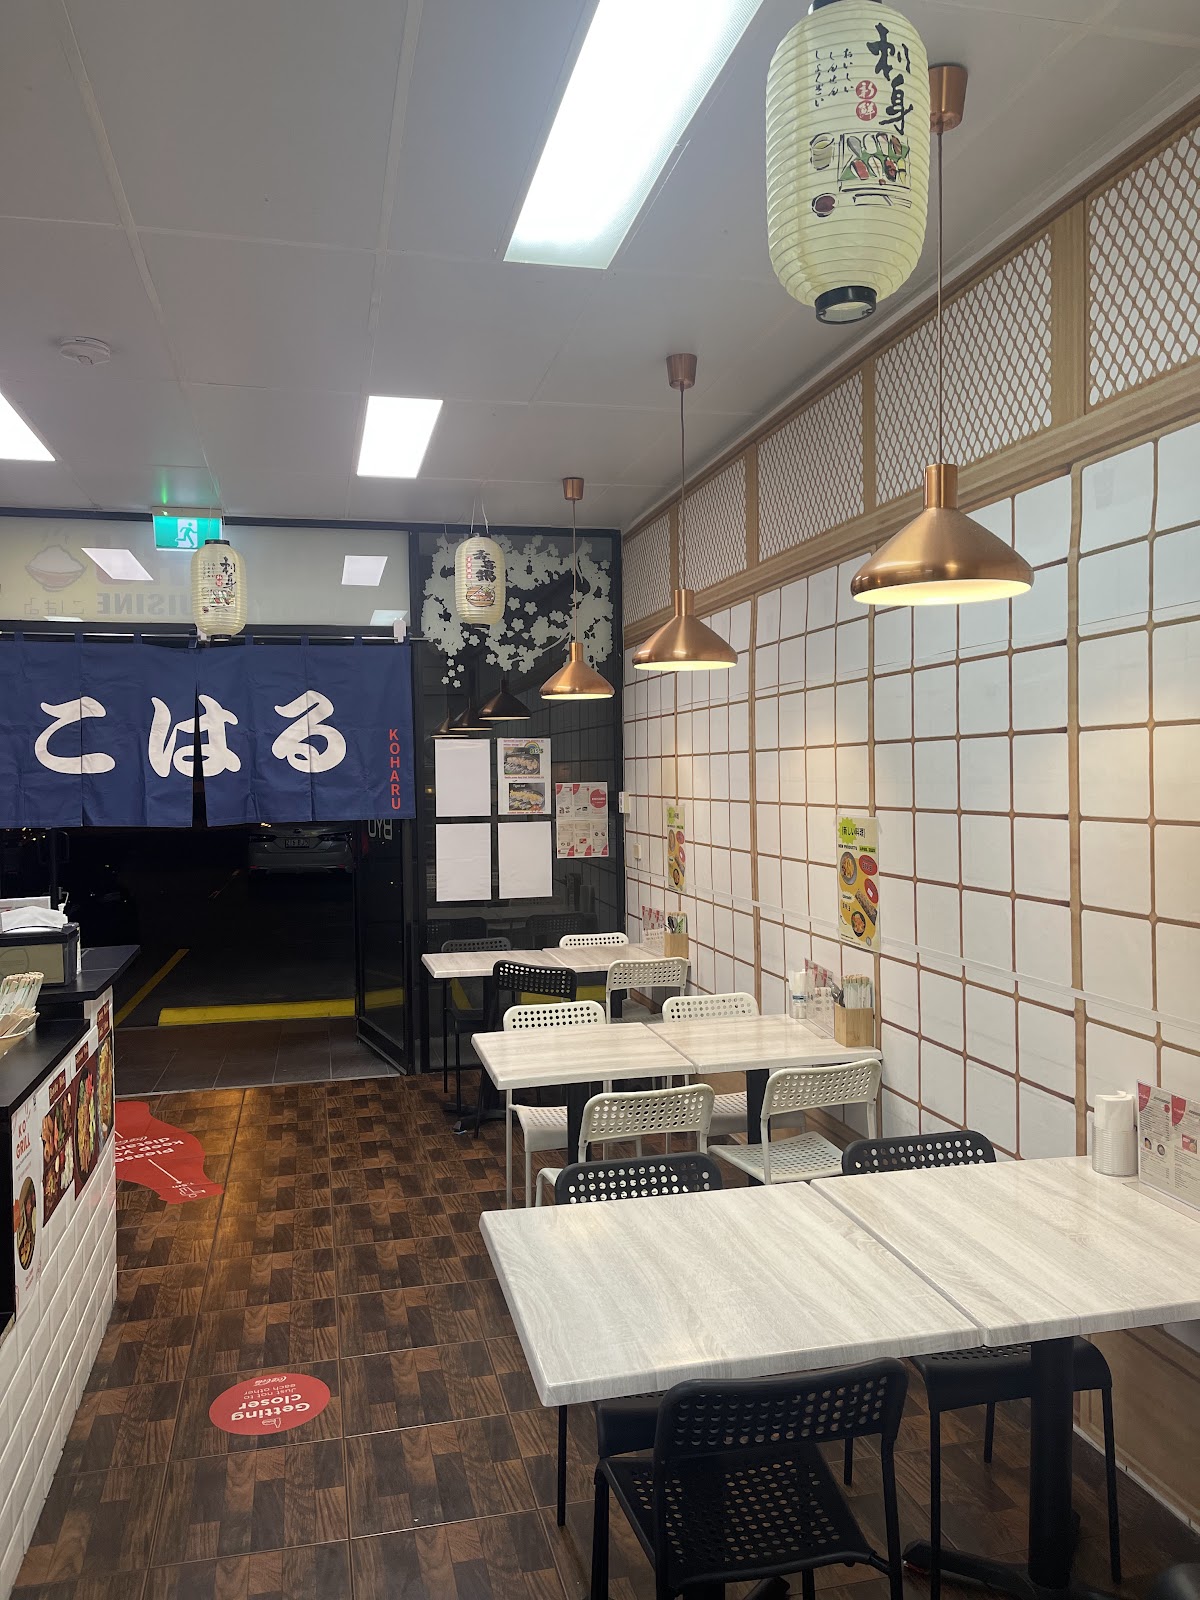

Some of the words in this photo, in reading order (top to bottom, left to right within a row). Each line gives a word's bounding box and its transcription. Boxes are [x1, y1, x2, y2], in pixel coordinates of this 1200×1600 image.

[827, 51, 839, 97] しんせん
[842, 47, 854, 93] おいしい
[33, 689, 348, 779] こはる
[388, 728, 402, 811] KOHARU
[115, 1137, 170, 1150] distan
[139, 1140, 184, 1151] keep
[243, 1386, 271, 1396] other
[256, 1390, 274, 1399] not
[274, 1383, 297, 1391] each
[238, 1393, 302, 1410] closer
[231, 1402, 311, 1422] Getting
